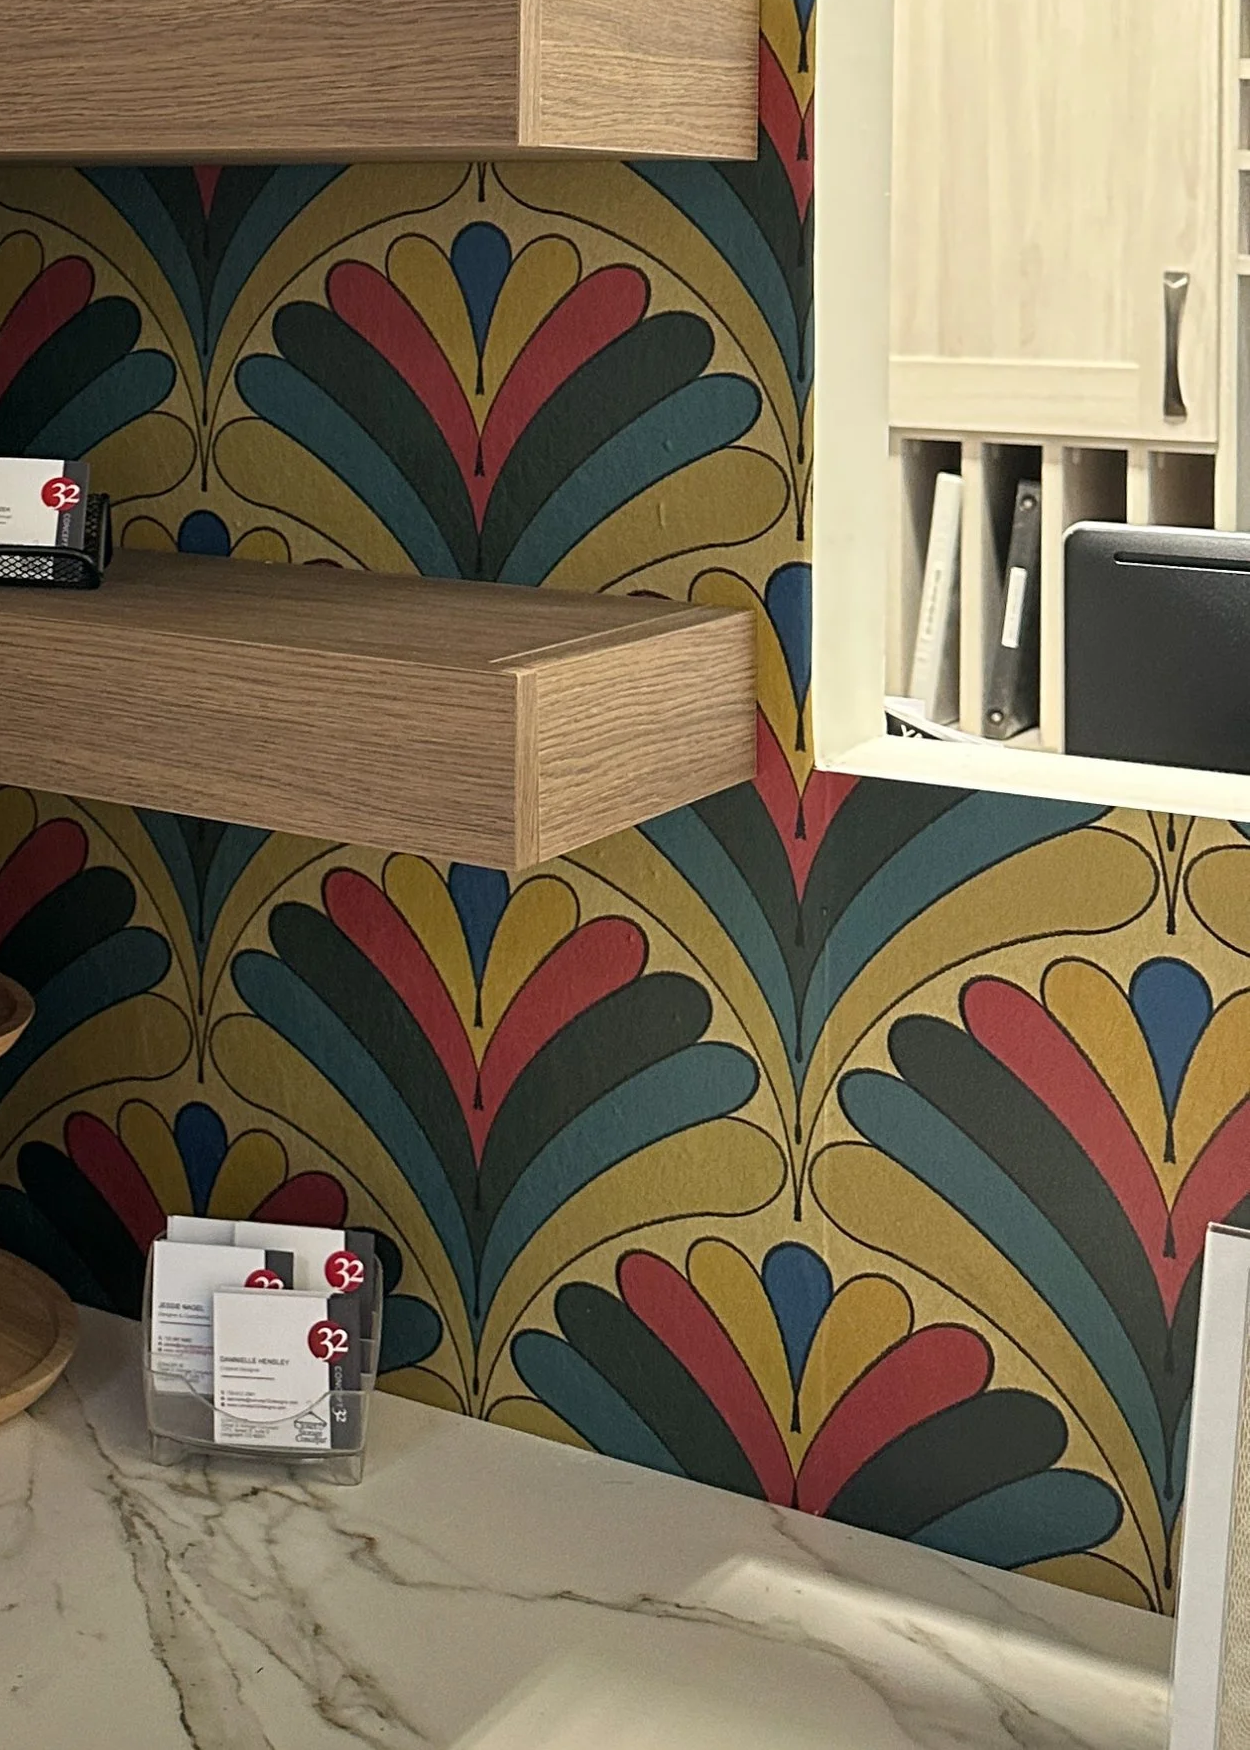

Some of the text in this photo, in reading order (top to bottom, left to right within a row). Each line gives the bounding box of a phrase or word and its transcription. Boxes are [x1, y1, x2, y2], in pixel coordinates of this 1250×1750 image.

[49, 482, 80, 510] 32
[332, 1257, 364, 1294] 32
[318, 1327, 349, 1363] 32
[332, 1407, 347, 1423] 32
